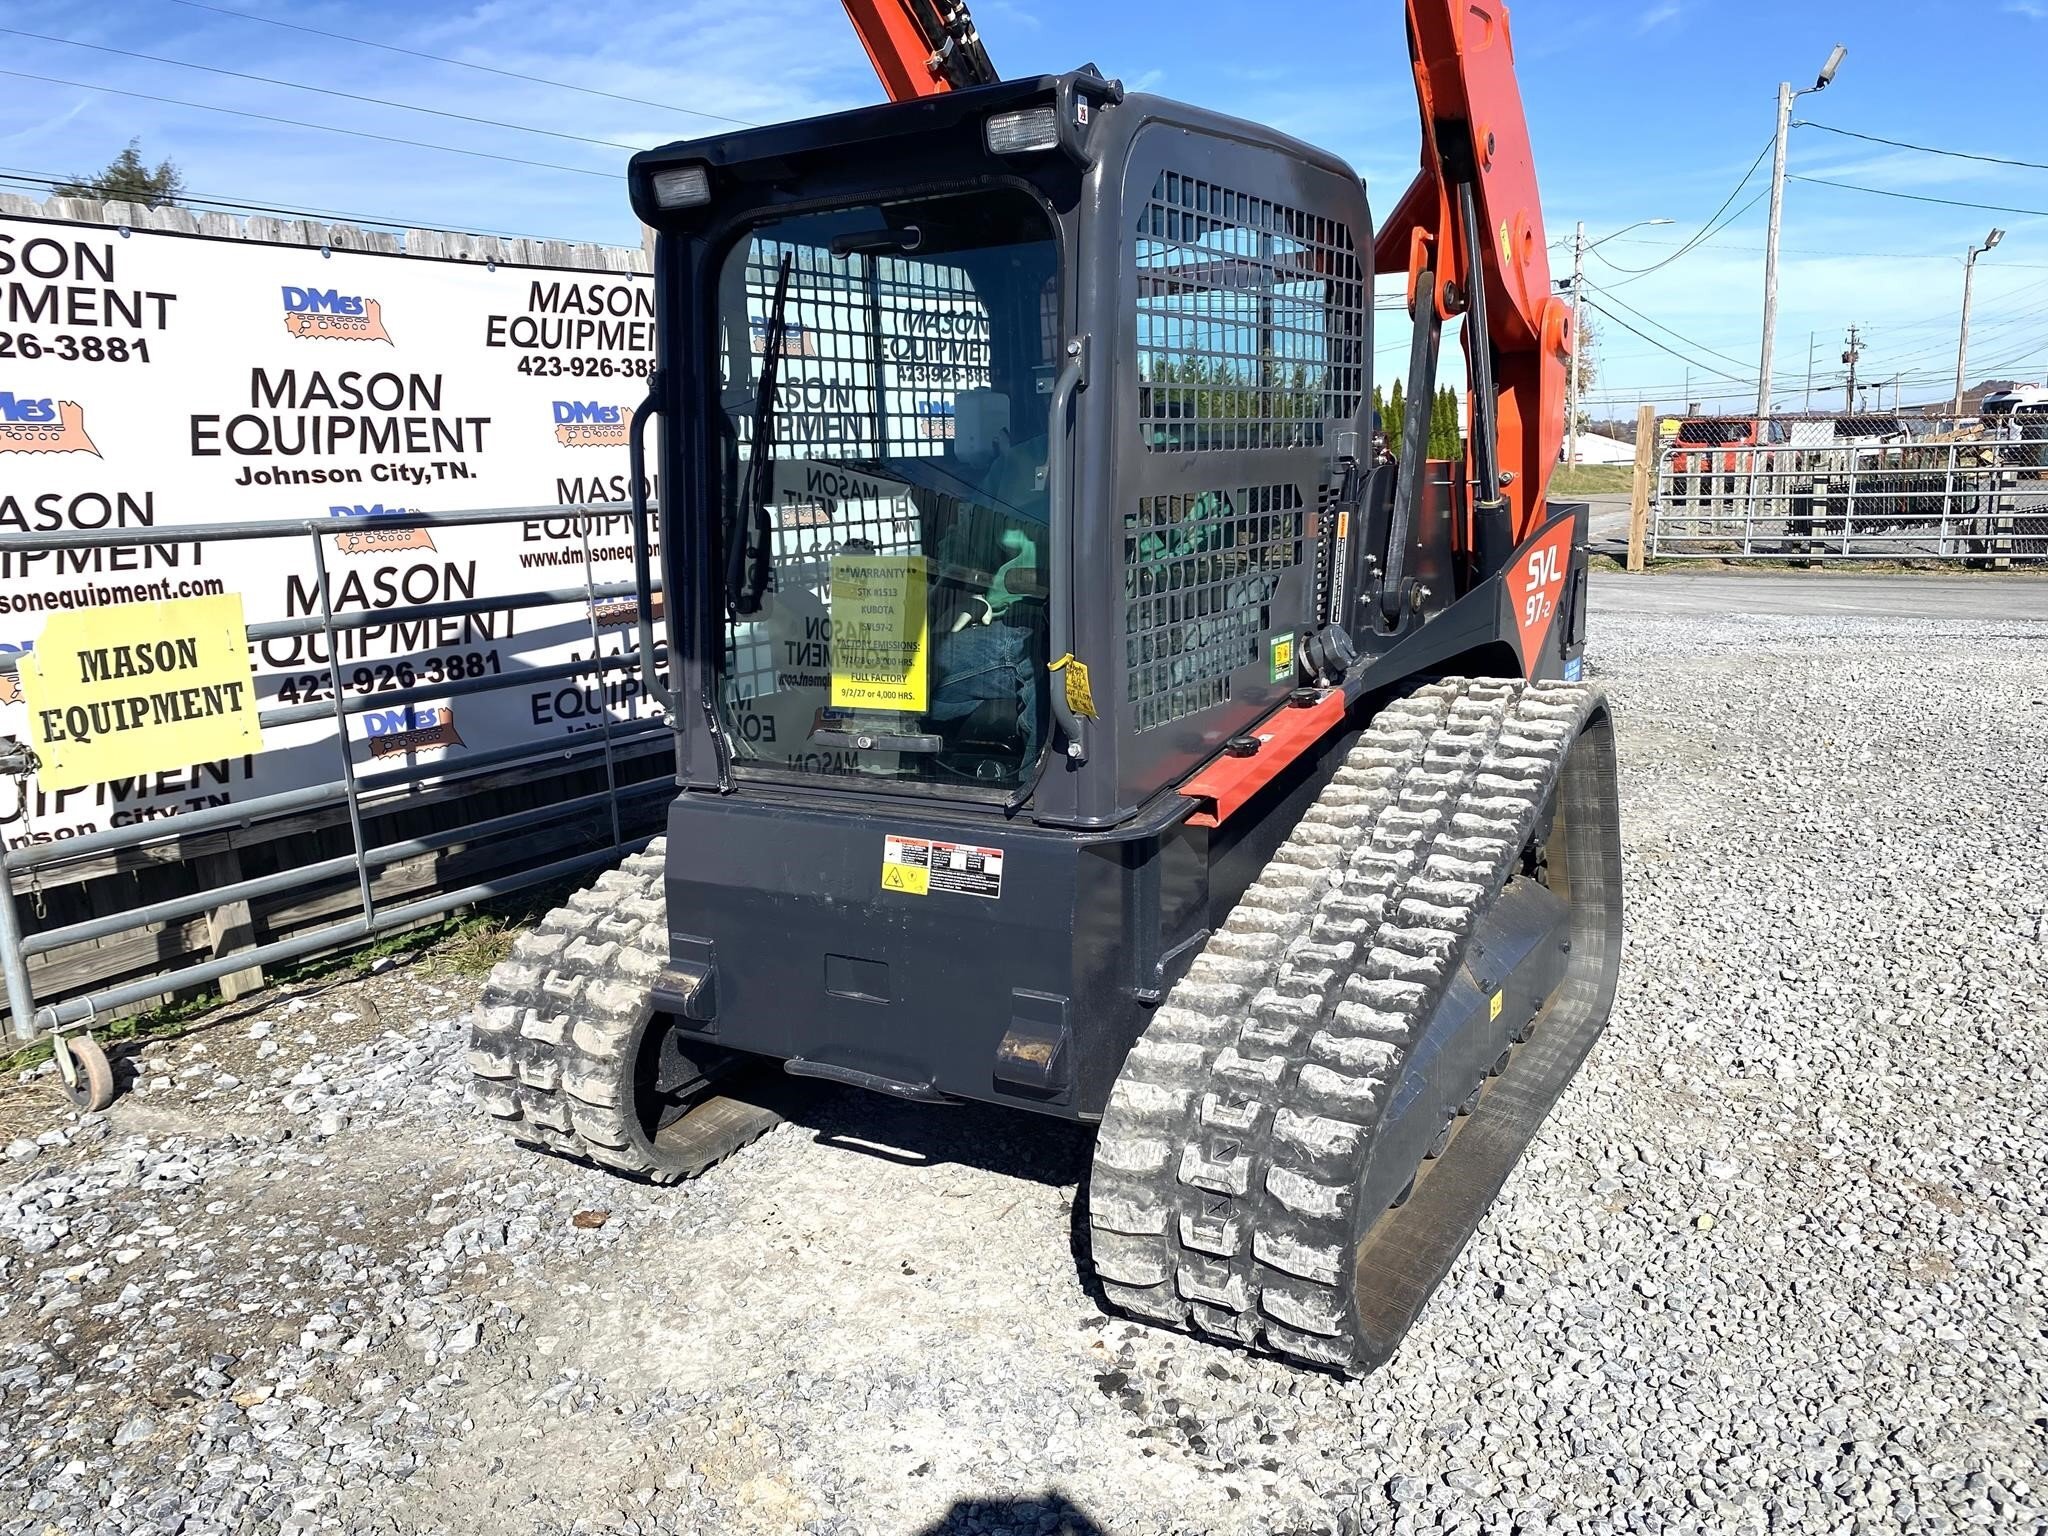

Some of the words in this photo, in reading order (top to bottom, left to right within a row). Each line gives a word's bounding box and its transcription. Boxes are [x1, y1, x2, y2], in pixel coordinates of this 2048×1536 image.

[528, 281, 655, 318] MASON
[251, 366, 443, 412] MASON
[190, 413, 491, 457] EQUIPMENT
[235, 465, 362, 487] Johnson
[1525, 544, 1563, 592] SVL
[286, 560, 477, 618] MASON
[857, 588, 872, 597] STK
[861, 605, 894, 615] KUBOTA
[77, 637, 199, 684] MASON
[851, 672, 870, 682] FULL
[871, 673, 908, 684] FACTORY
[39, 681, 244, 744] EQUIPMENT
[841, 688, 866, 698] 9/2/27
[876, 690, 897, 700] 4,000
